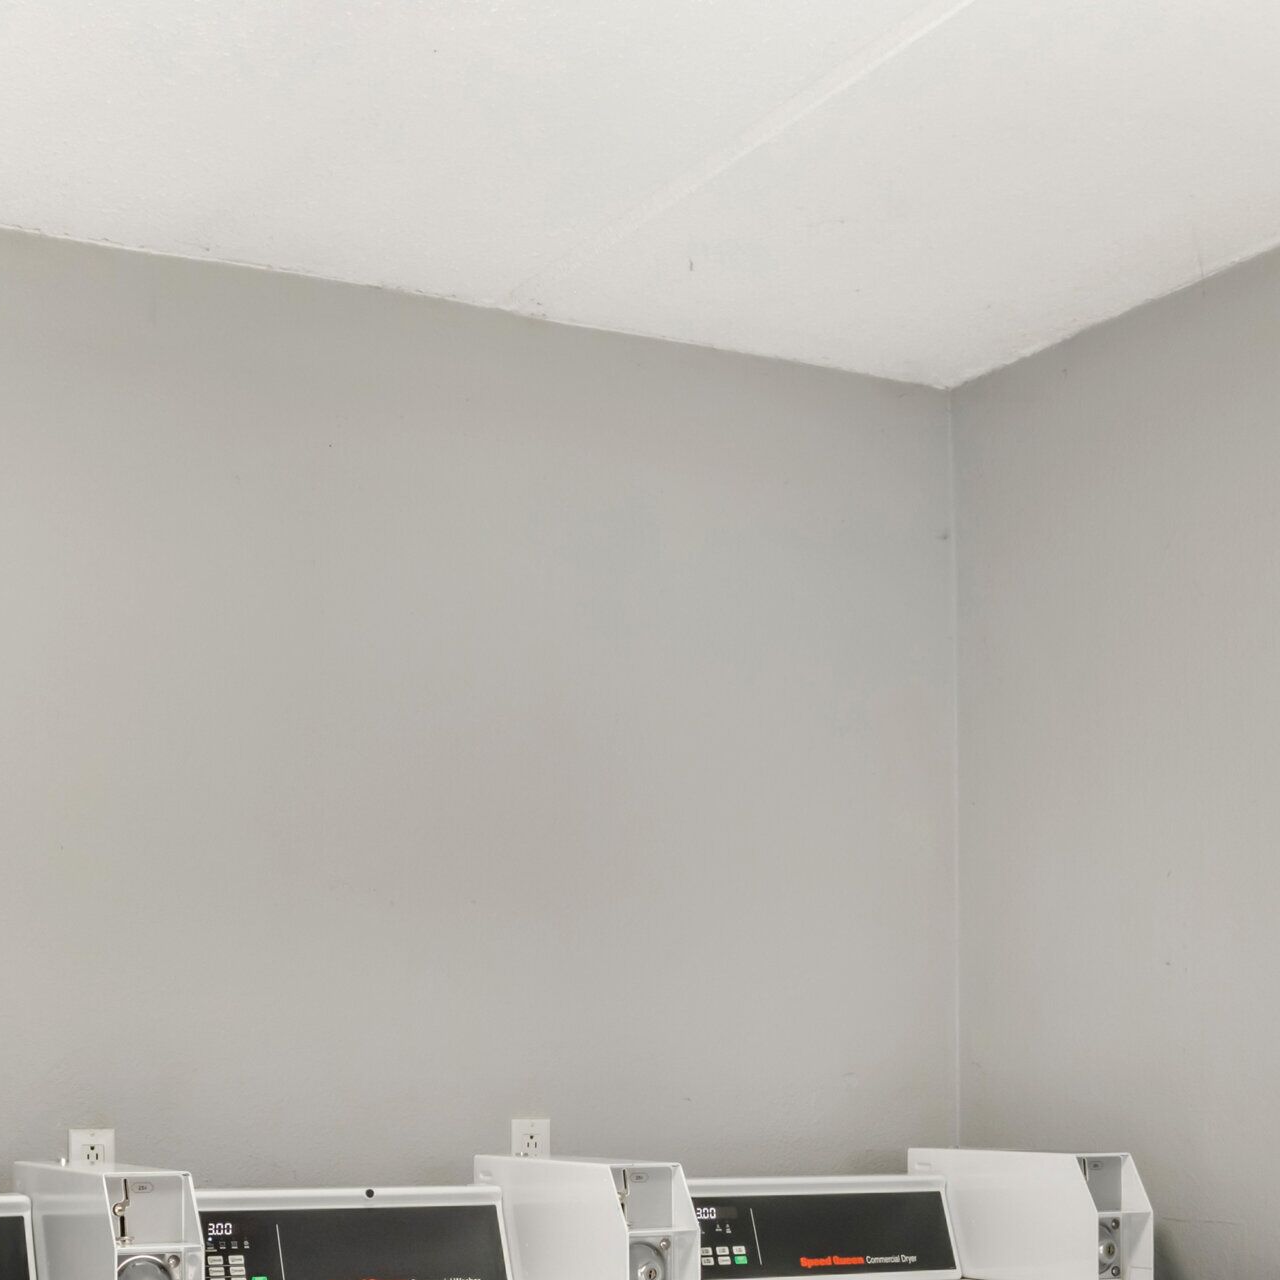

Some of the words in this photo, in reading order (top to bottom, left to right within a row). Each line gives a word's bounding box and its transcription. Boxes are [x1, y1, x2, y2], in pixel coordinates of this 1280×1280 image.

[800, 1256, 832, 1268] Speed
[833, 1255, 865, 1266] Queen
[866, 1254, 900, 1264] Commercial
[901, 1254, 917, 1263] Dryer
